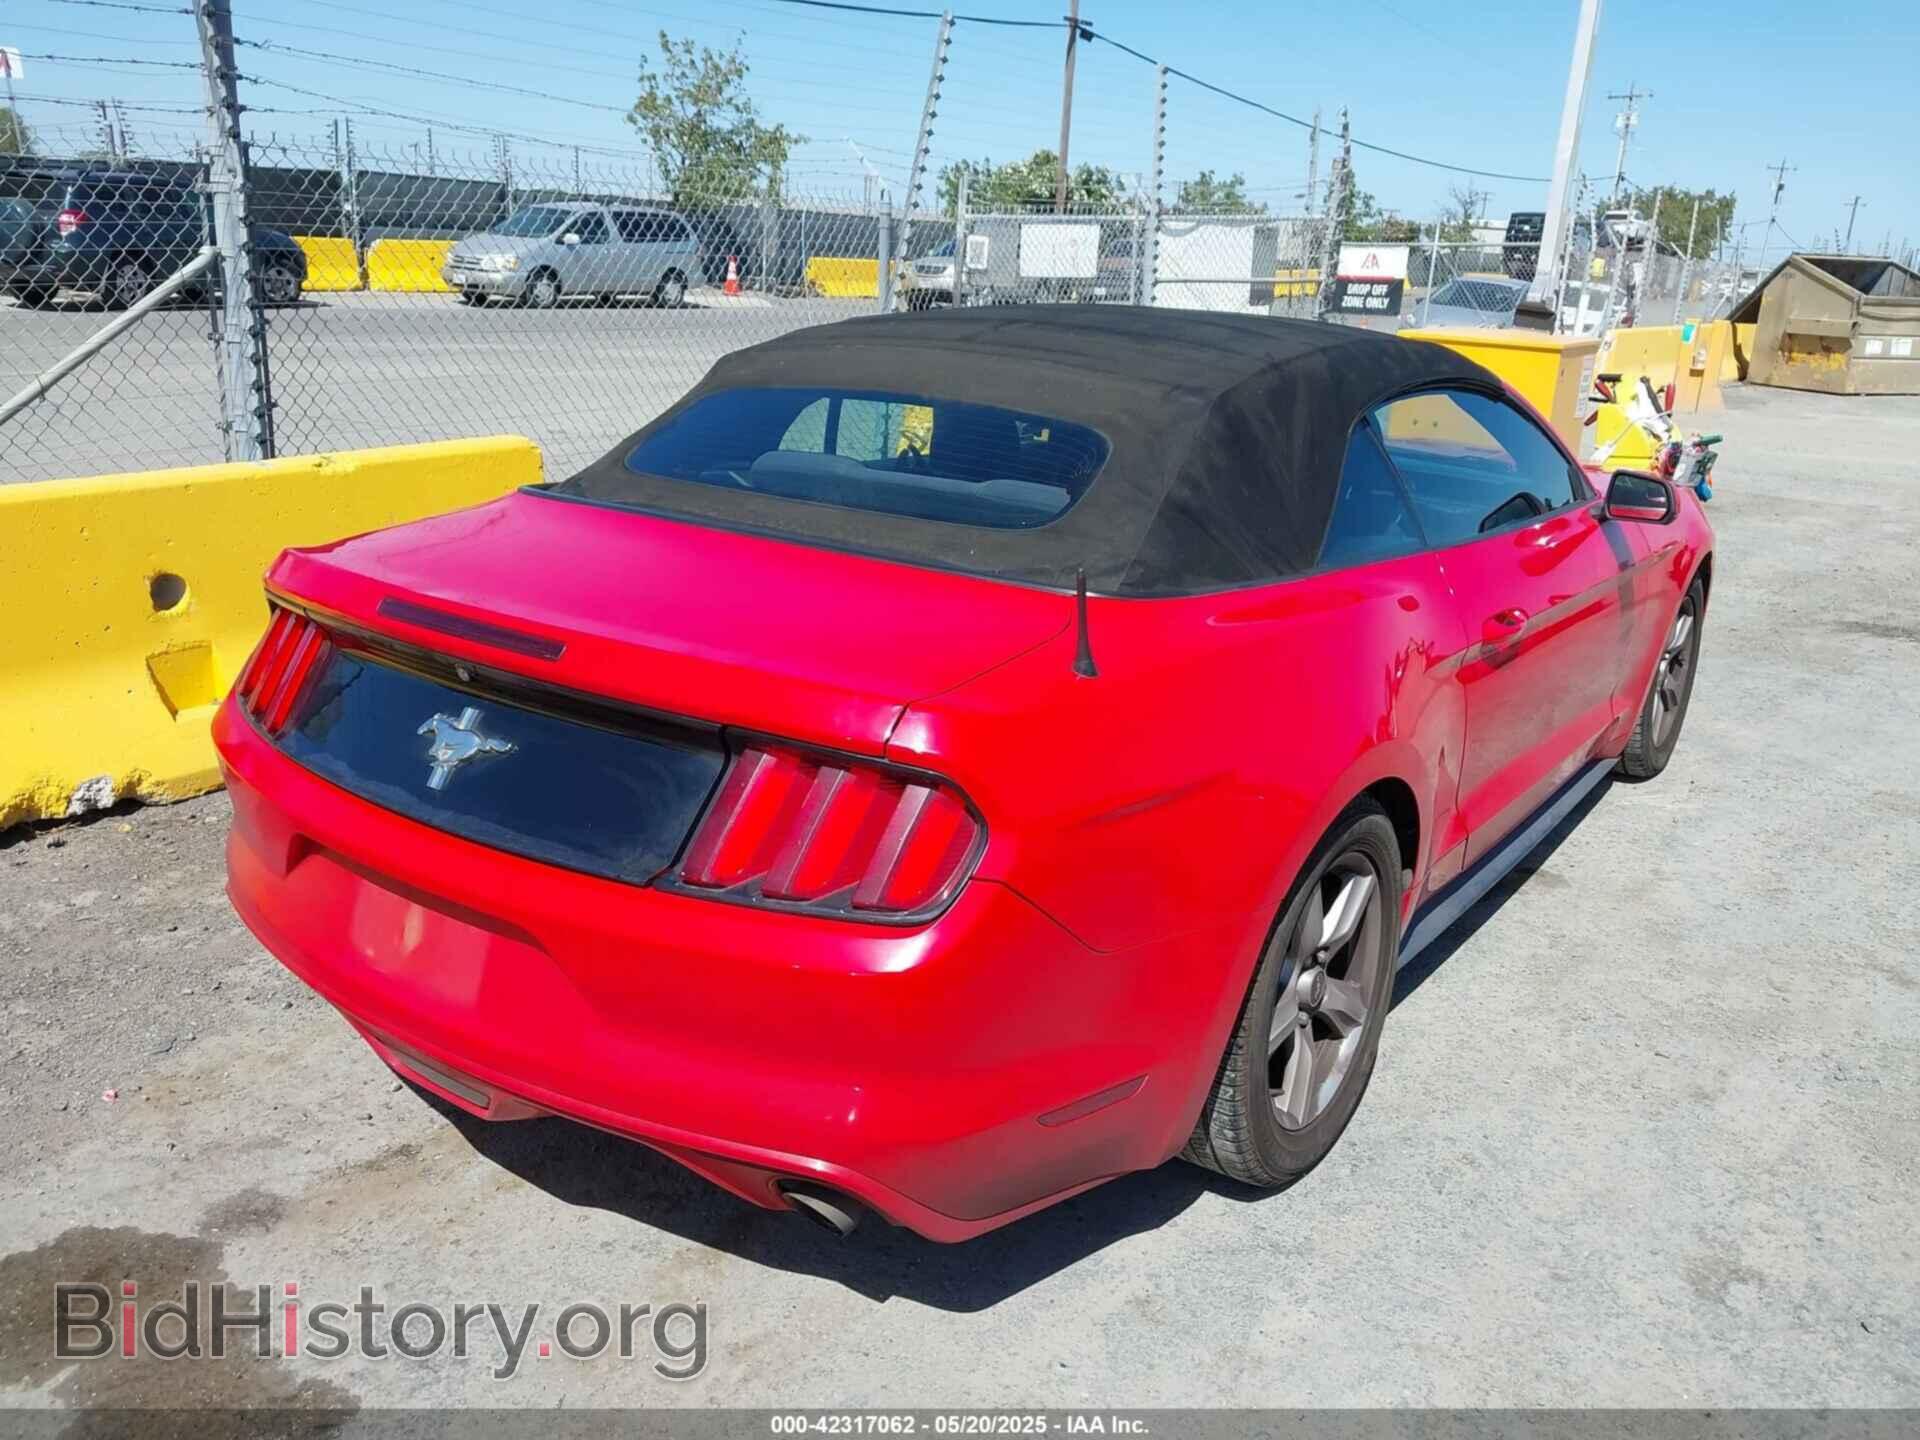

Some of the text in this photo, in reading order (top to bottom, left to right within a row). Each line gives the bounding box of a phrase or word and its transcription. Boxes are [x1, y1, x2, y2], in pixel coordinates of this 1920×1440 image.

[1346, 283, 1389, 296] DROP OFF
[1341, 295, 1390, 309] ZONE ONLY
